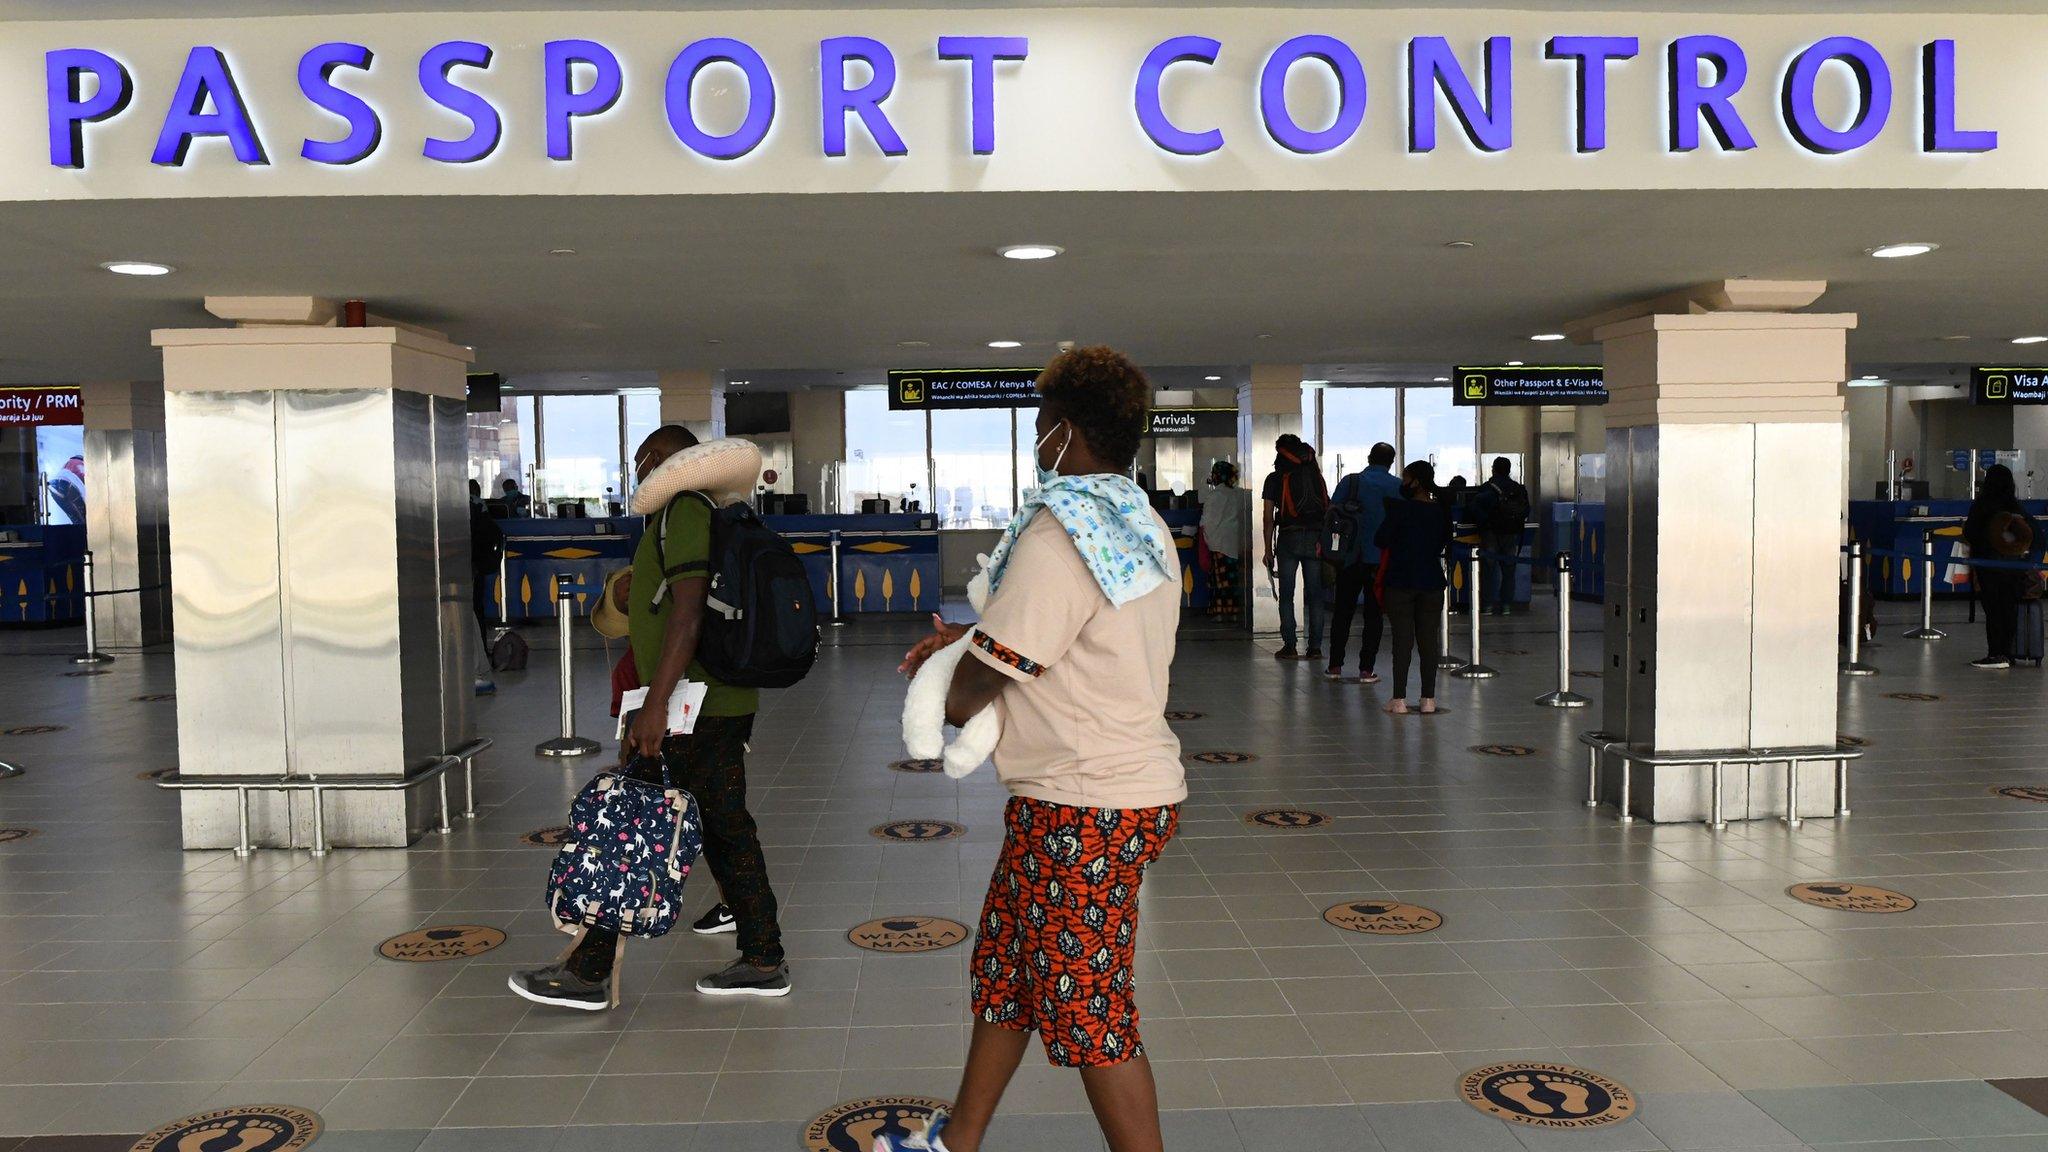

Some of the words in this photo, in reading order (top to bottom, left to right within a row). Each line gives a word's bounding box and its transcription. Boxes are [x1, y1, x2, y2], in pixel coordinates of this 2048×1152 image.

[45, 36, 1029, 168] PASSPORT
[1133, 34, 1999, 157] CONTROL
[931, 381, 948, 390] EAC
[956, 380, 992, 390] COMESA
[999, 380, 1025, 390] Kenya
[1493, 378, 1517, 387] Other
[1519, 378, 1554, 388] Passport
[1556, 378, 1563, 387] &
[1564, 378, 1590, 387] E-Visa
[2013, 374, 2039, 387] Visa
[2012, 390, 2047, 400] Waombaji
[35, 395, 42, 409] /
[46, 394, 78, 408] PRM
[1153, 414, 1196, 425] Arrivals
[860, 932, 932, 940] WEAR
[394, 941, 465, 949] WEAR
[873, 940, 943, 948] MASK
[396, 949, 467, 957] MASK
[1464, 1077, 1484, 1101] PLEASE
[1475, 1065, 1504, 1079] KEEP
[1507, 1063, 1566, 1073] SOCIAL
[187, 1109, 234, 1124] KEEP
[238, 1106, 295, 1119] SOCIAL
[809, 1113, 838, 1141] PLEASE
[833, 1100, 871, 1115] KEEP
[875, 1097, 934, 1107] SOCIAL
[1512, 1115, 1576, 1128] STAND
[1580, 1113, 1620, 1126] HERE
